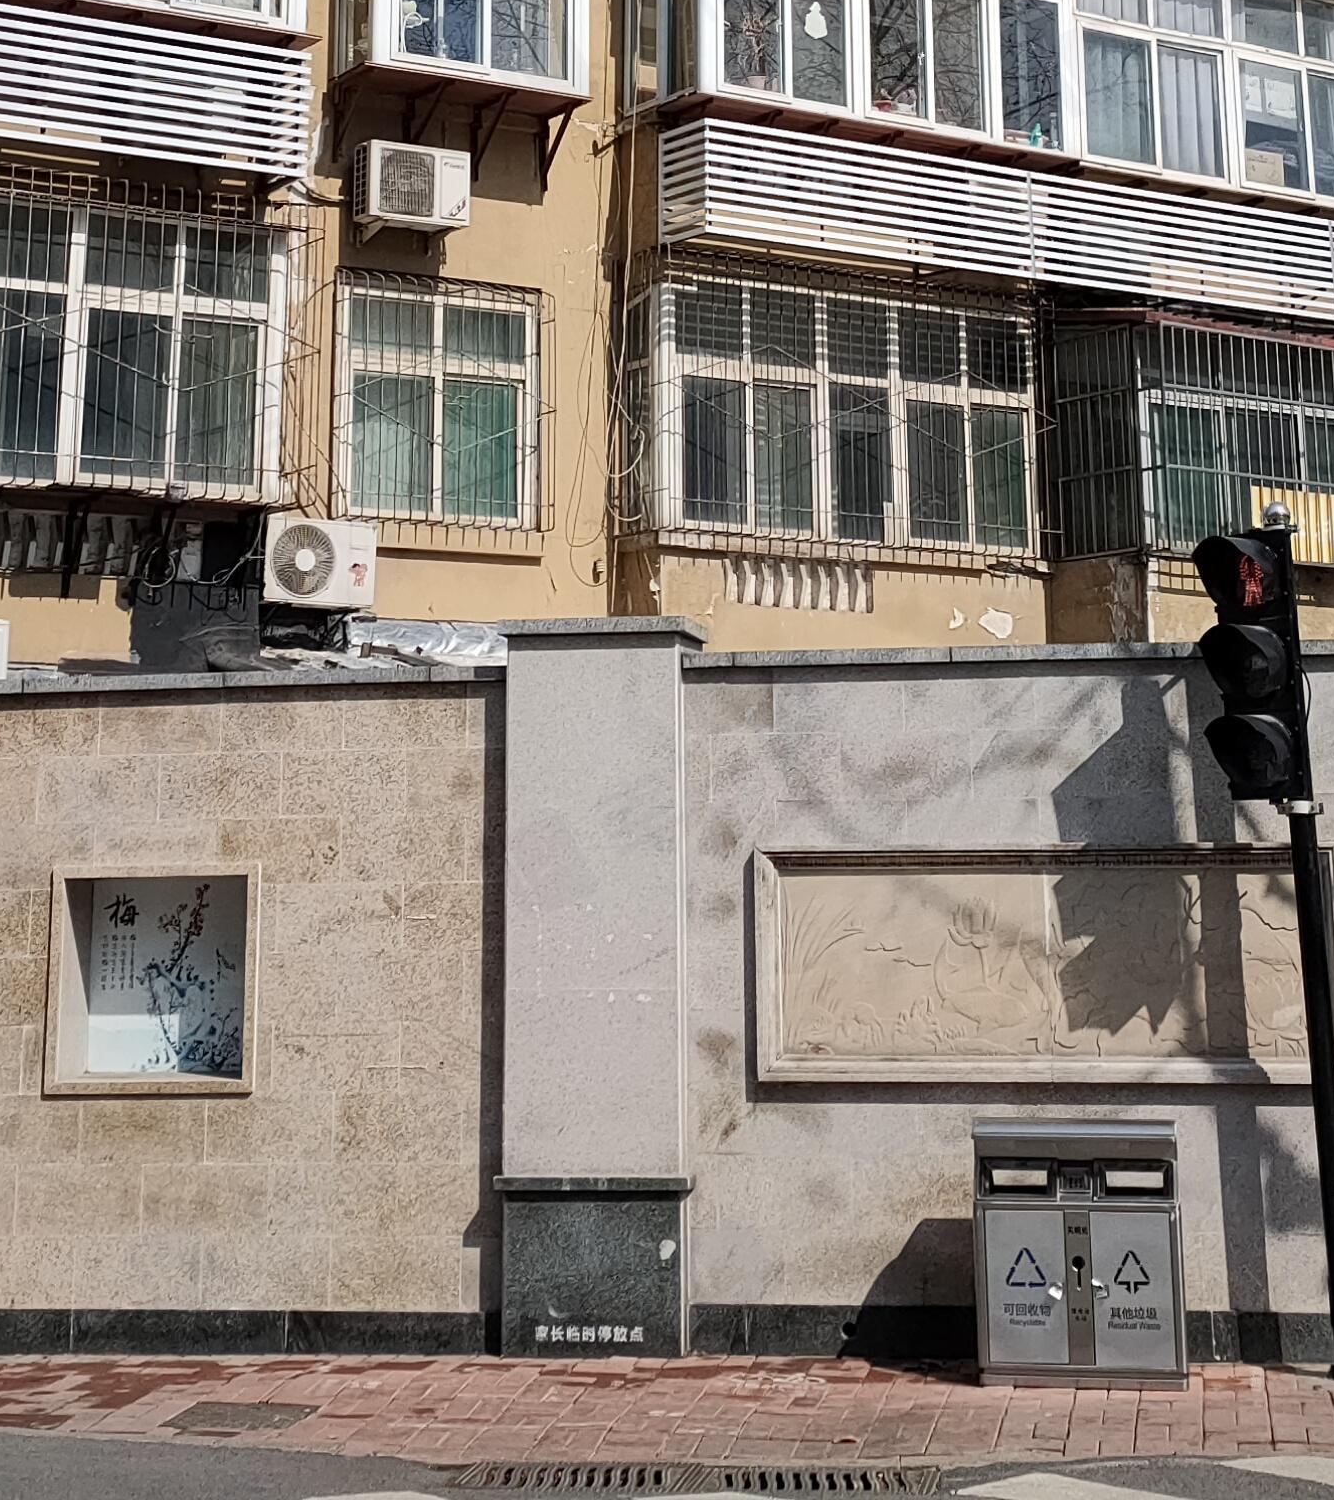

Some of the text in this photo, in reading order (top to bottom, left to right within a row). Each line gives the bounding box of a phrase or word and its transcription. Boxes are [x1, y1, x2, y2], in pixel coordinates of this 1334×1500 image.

[104, 893, 139, 928] 梅
[1003, 1303, 1051, 1317] 可回收物
[1109, 1306, 1158, 1320] 其他垃圾
[534, 1324, 644, 1343] 家长临时停放点
